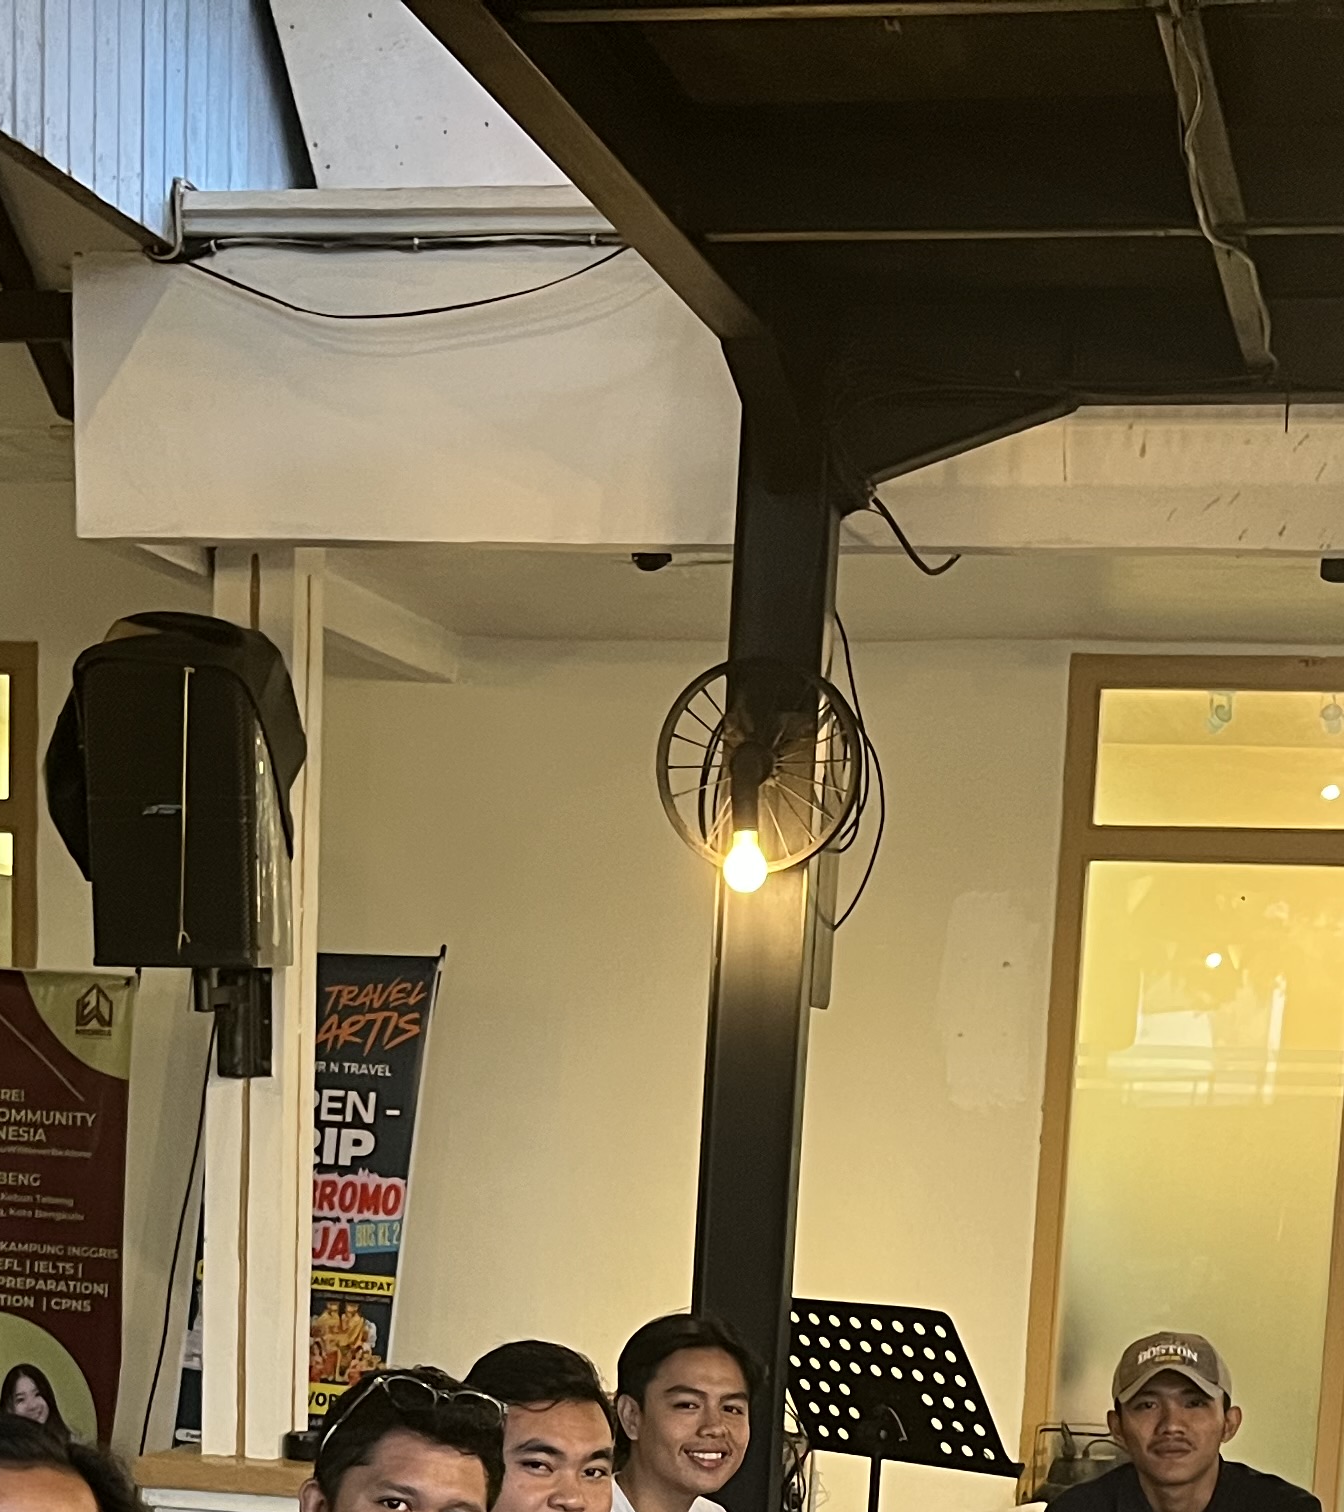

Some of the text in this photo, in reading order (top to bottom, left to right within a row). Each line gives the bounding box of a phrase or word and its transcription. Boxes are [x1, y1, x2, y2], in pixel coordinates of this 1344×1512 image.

[324, 975, 427, 1016] TRAVEL
[316, 1011, 421, 1057] ARTIS
[330, 1062, 339, 1073] N
[343, 1062, 392, 1077] TRAVEL
[0, 1241, 64, 1256] KAMPUNG
[67, 1245, 118, 1259] INGGRIS
[34, 1260, 74, 1275] IELTS
[338, 1278, 393, 1292] TERCEPAT
[51, 1298, 91, 1312] CPNS
